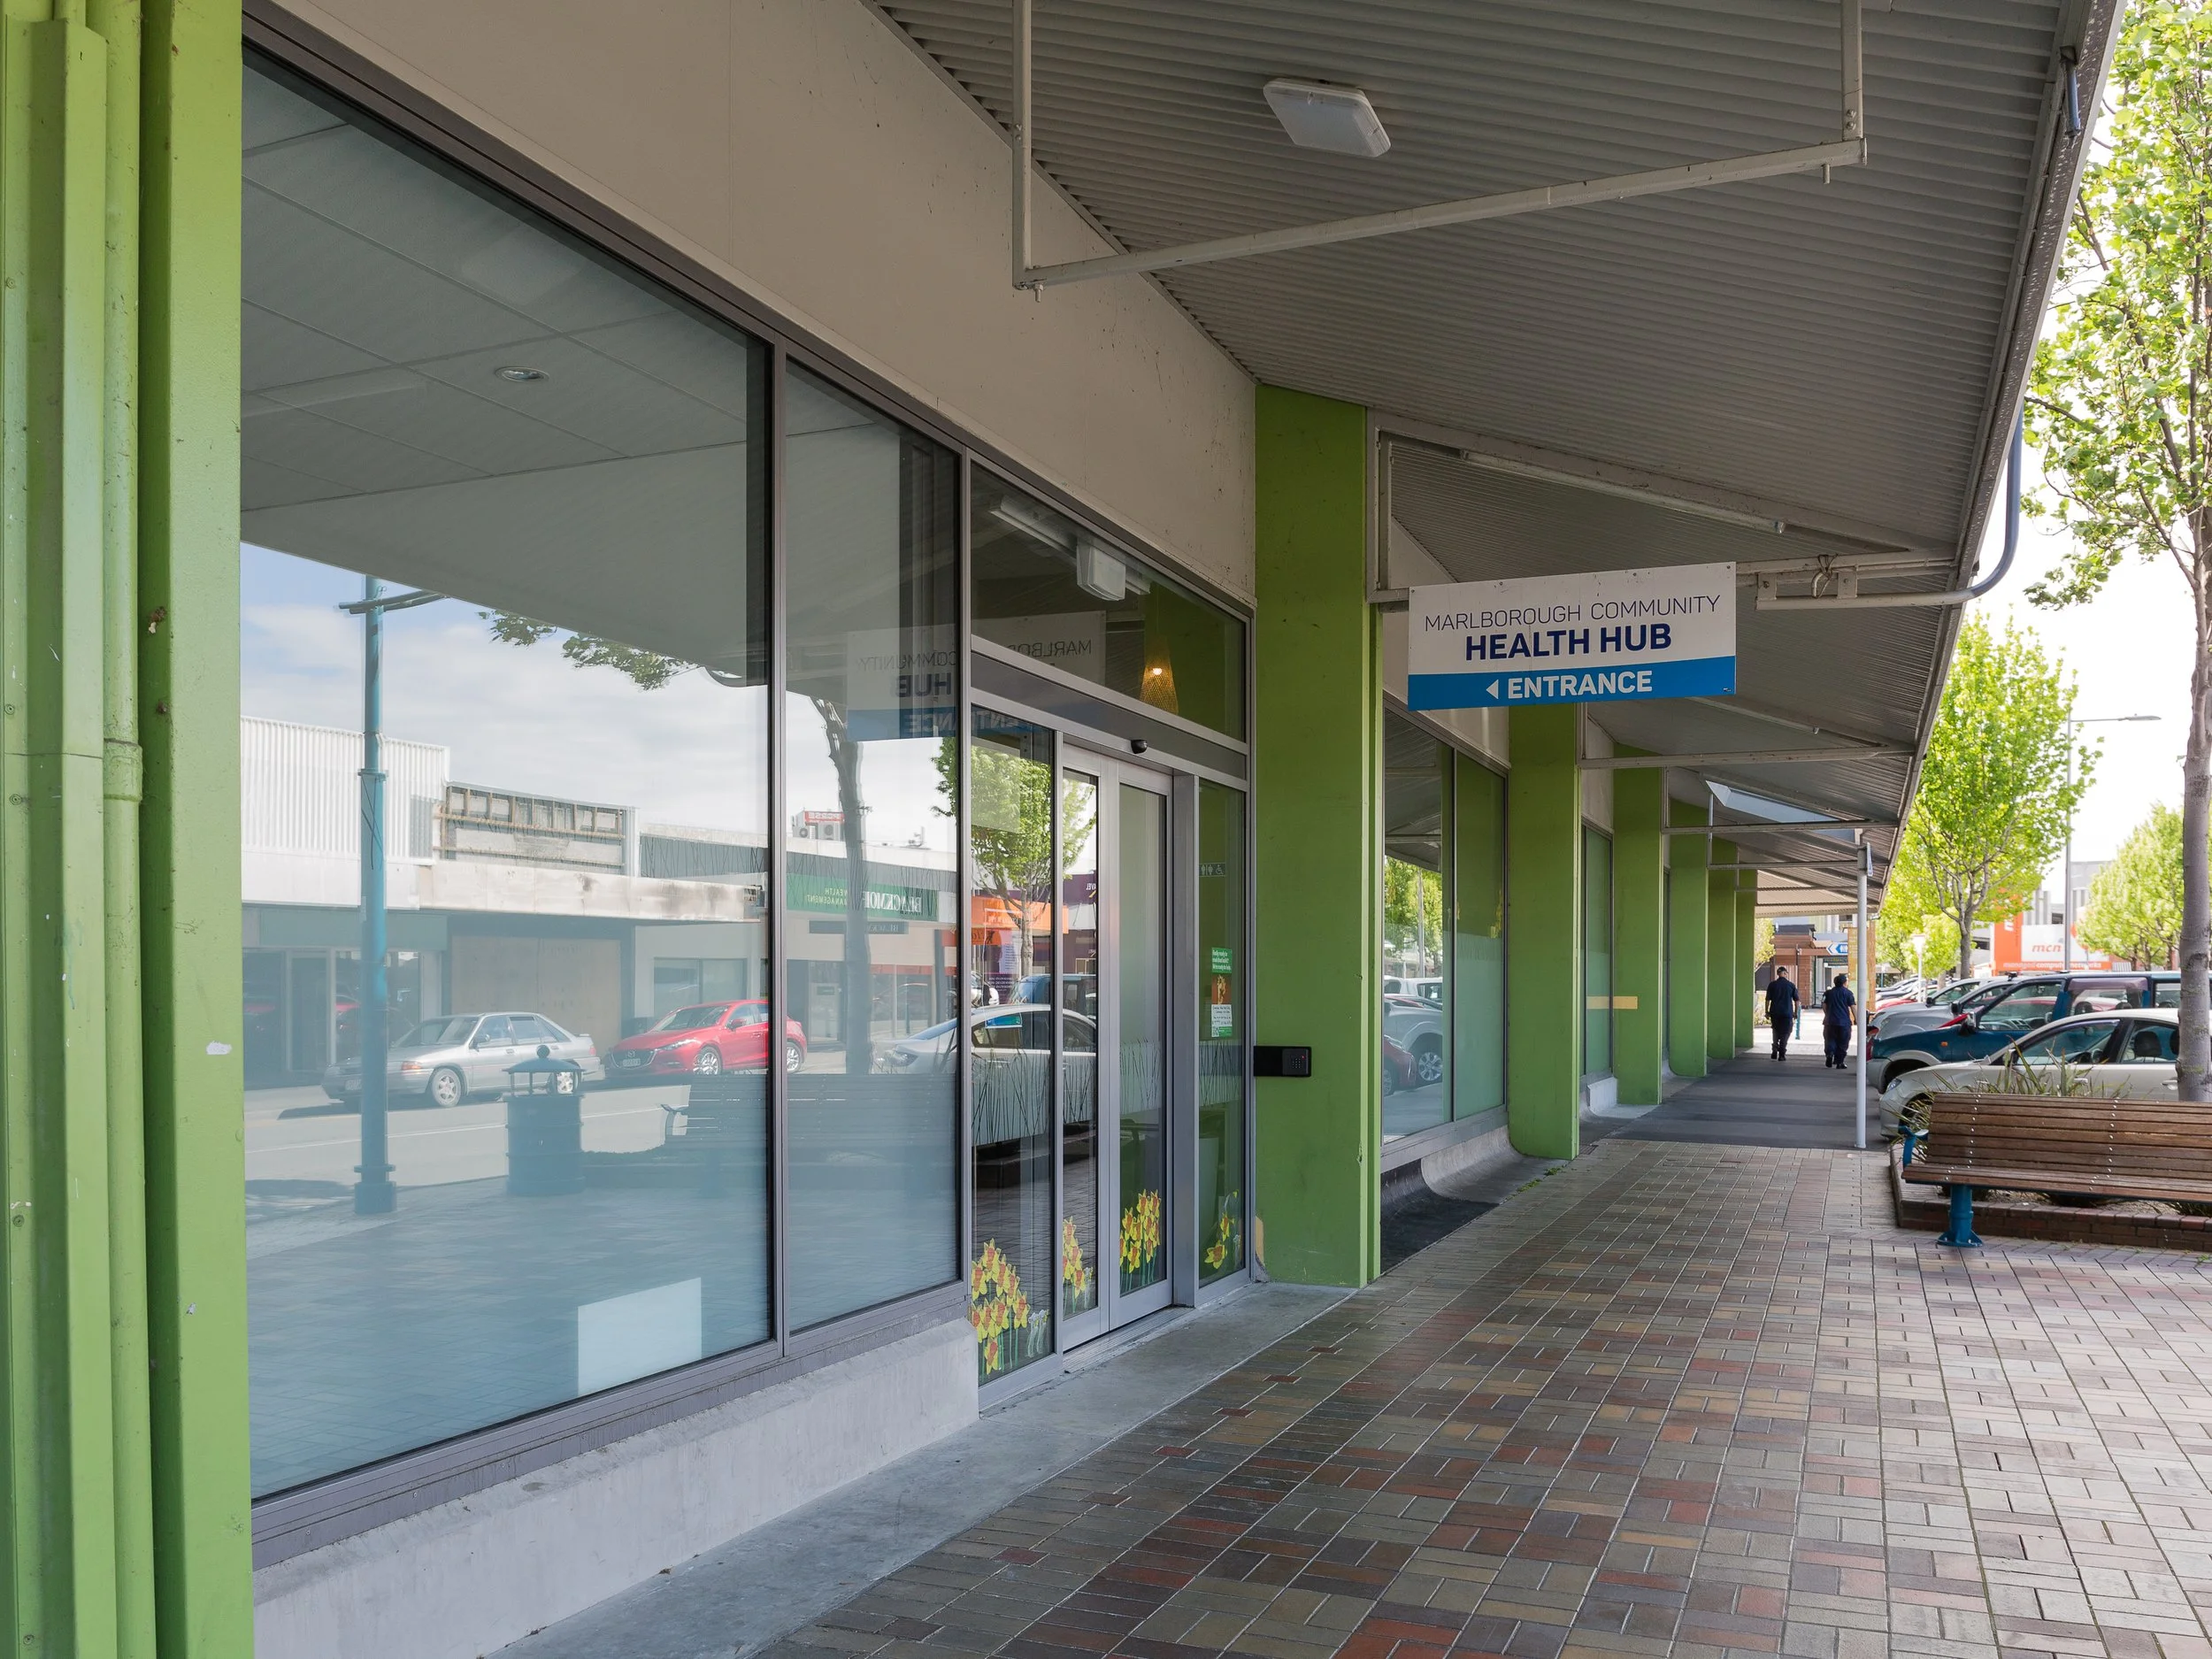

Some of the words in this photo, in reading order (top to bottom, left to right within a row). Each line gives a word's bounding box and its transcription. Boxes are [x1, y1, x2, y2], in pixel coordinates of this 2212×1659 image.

[1425, 604, 1580, 632] MARLBOROUGH
[1591, 595, 1721, 620] COMMUNITY
[1465, 629, 1589, 661] HEALTH
[1600, 623, 1672, 651] HUB
[1508, 671, 1653, 699] ENTRANCE
